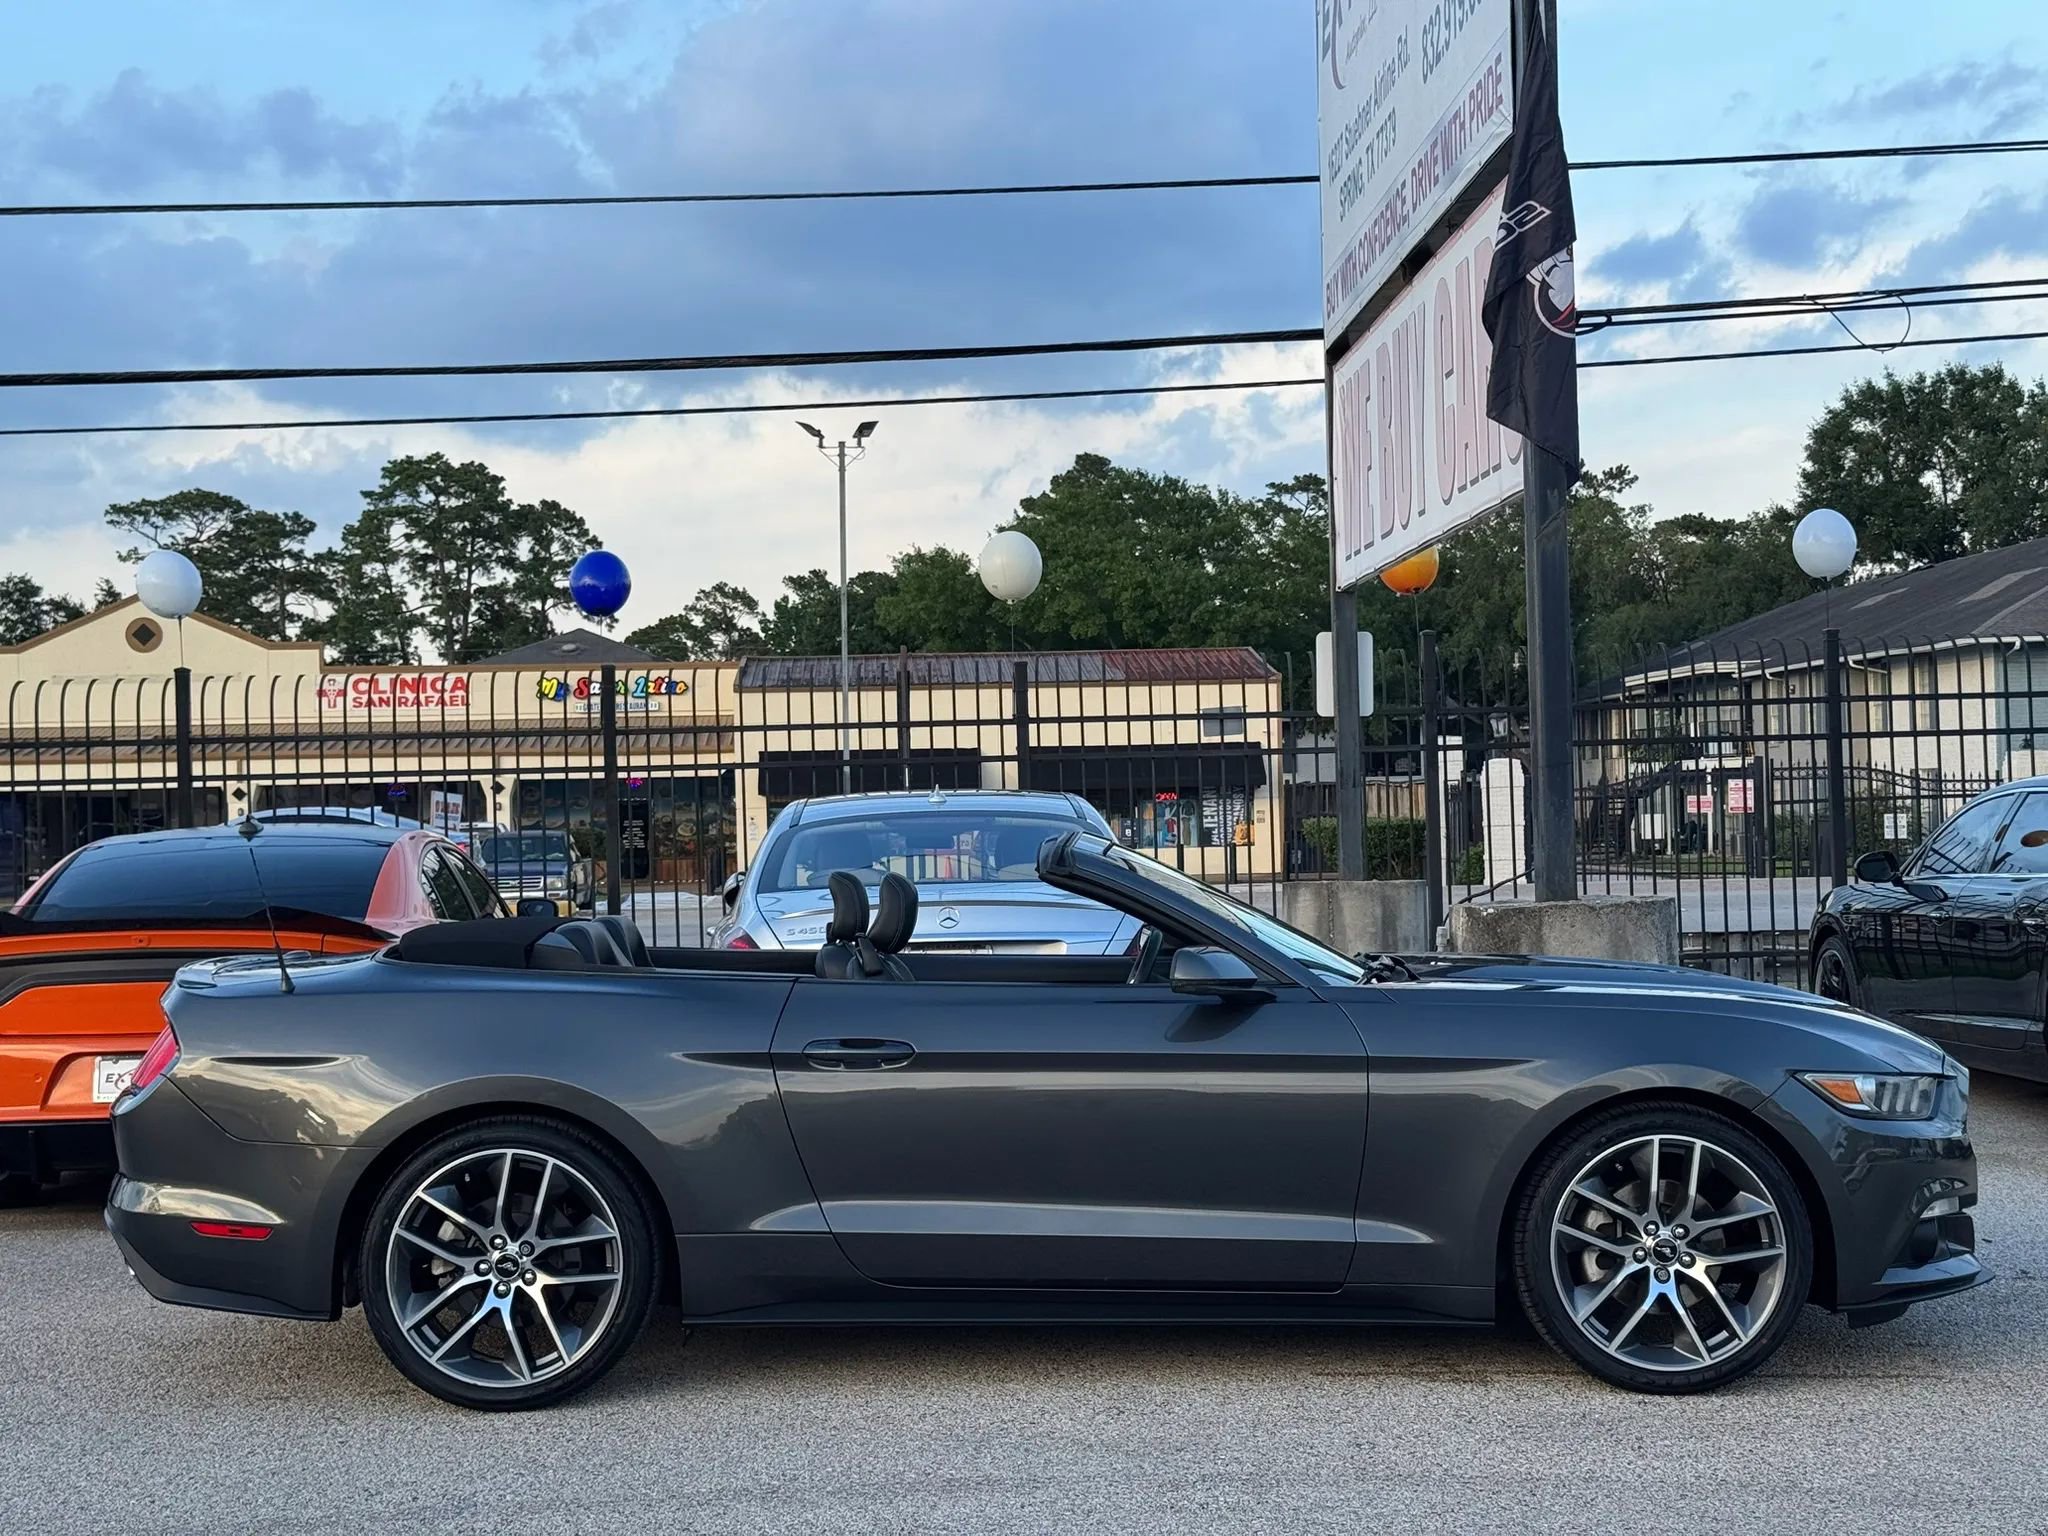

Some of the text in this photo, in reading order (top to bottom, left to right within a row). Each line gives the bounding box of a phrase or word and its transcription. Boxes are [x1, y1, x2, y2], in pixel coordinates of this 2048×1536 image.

[1374, 57, 1396, 117] Airline
[1398, 24, 1411, 78] Rd.
[1422, 0, 1481, 84] 832.919.
[1326, 52, 1503, 320] BUY WITH CONFIDENCE, DRIVE WITH PRIDE
[1340, 106, 1396, 222] SPRING, TX 77379
[1339, 236, 1523, 561] WE BUY CAR
[352, 677, 468, 695] CLINICA
[352, 695, 470, 708] SAN RAFAEL
[574, 677, 628, 699] Sar
[632, 676, 689, 698] Latino
